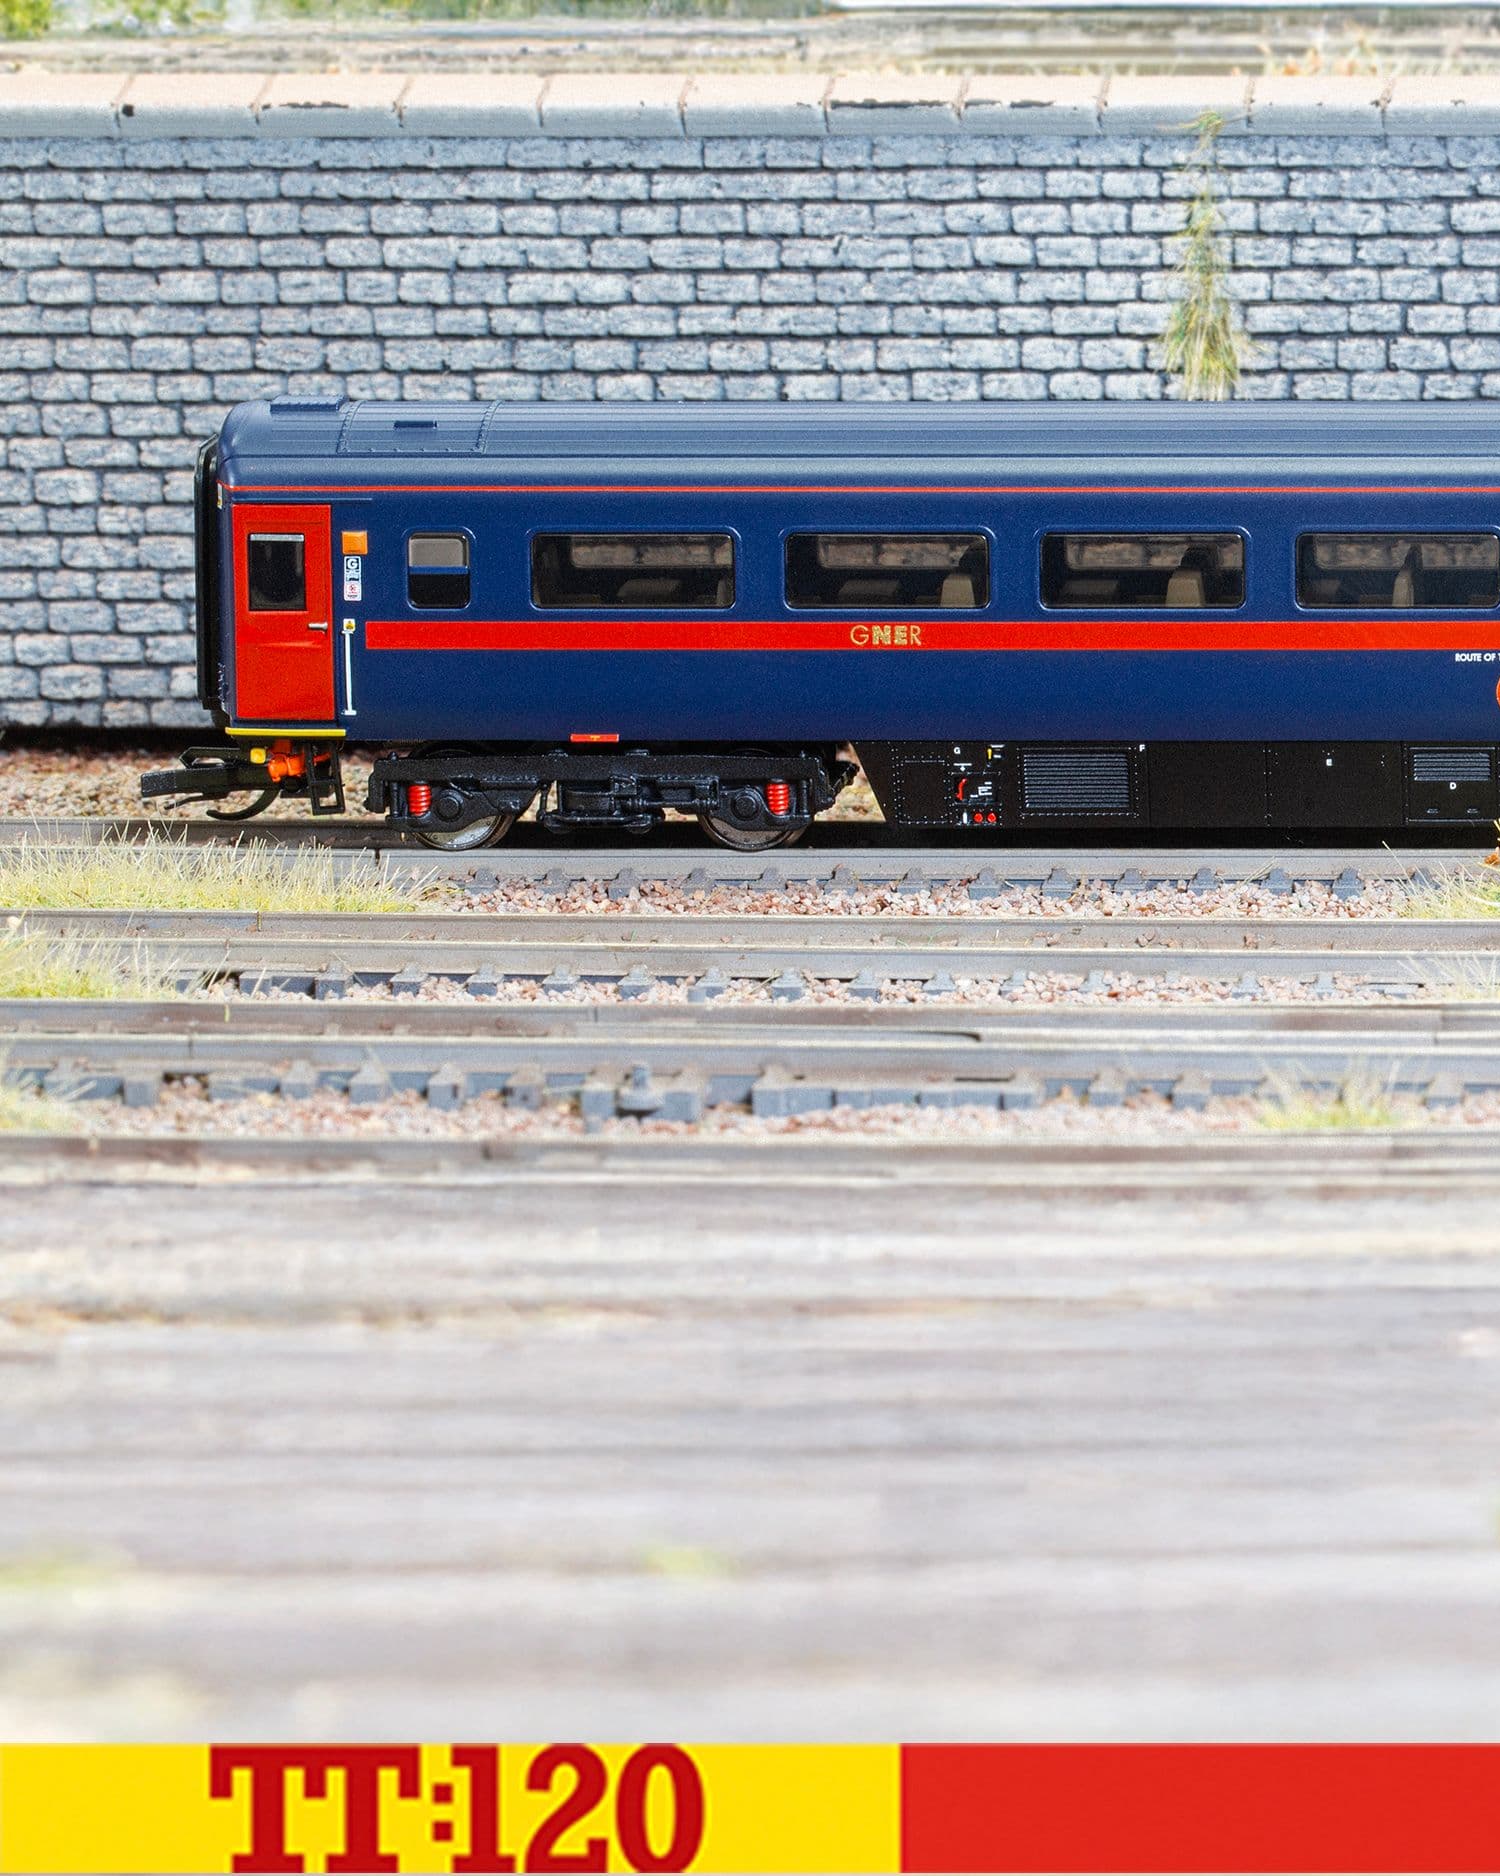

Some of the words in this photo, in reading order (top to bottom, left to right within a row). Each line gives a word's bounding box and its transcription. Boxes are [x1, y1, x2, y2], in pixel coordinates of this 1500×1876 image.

[348, 558, 358, 569] G
[850, 624, 921, 646] GNER
[1455, 653, 1482, 662] ROUTE
[1483, 653, 1496, 662] OF
